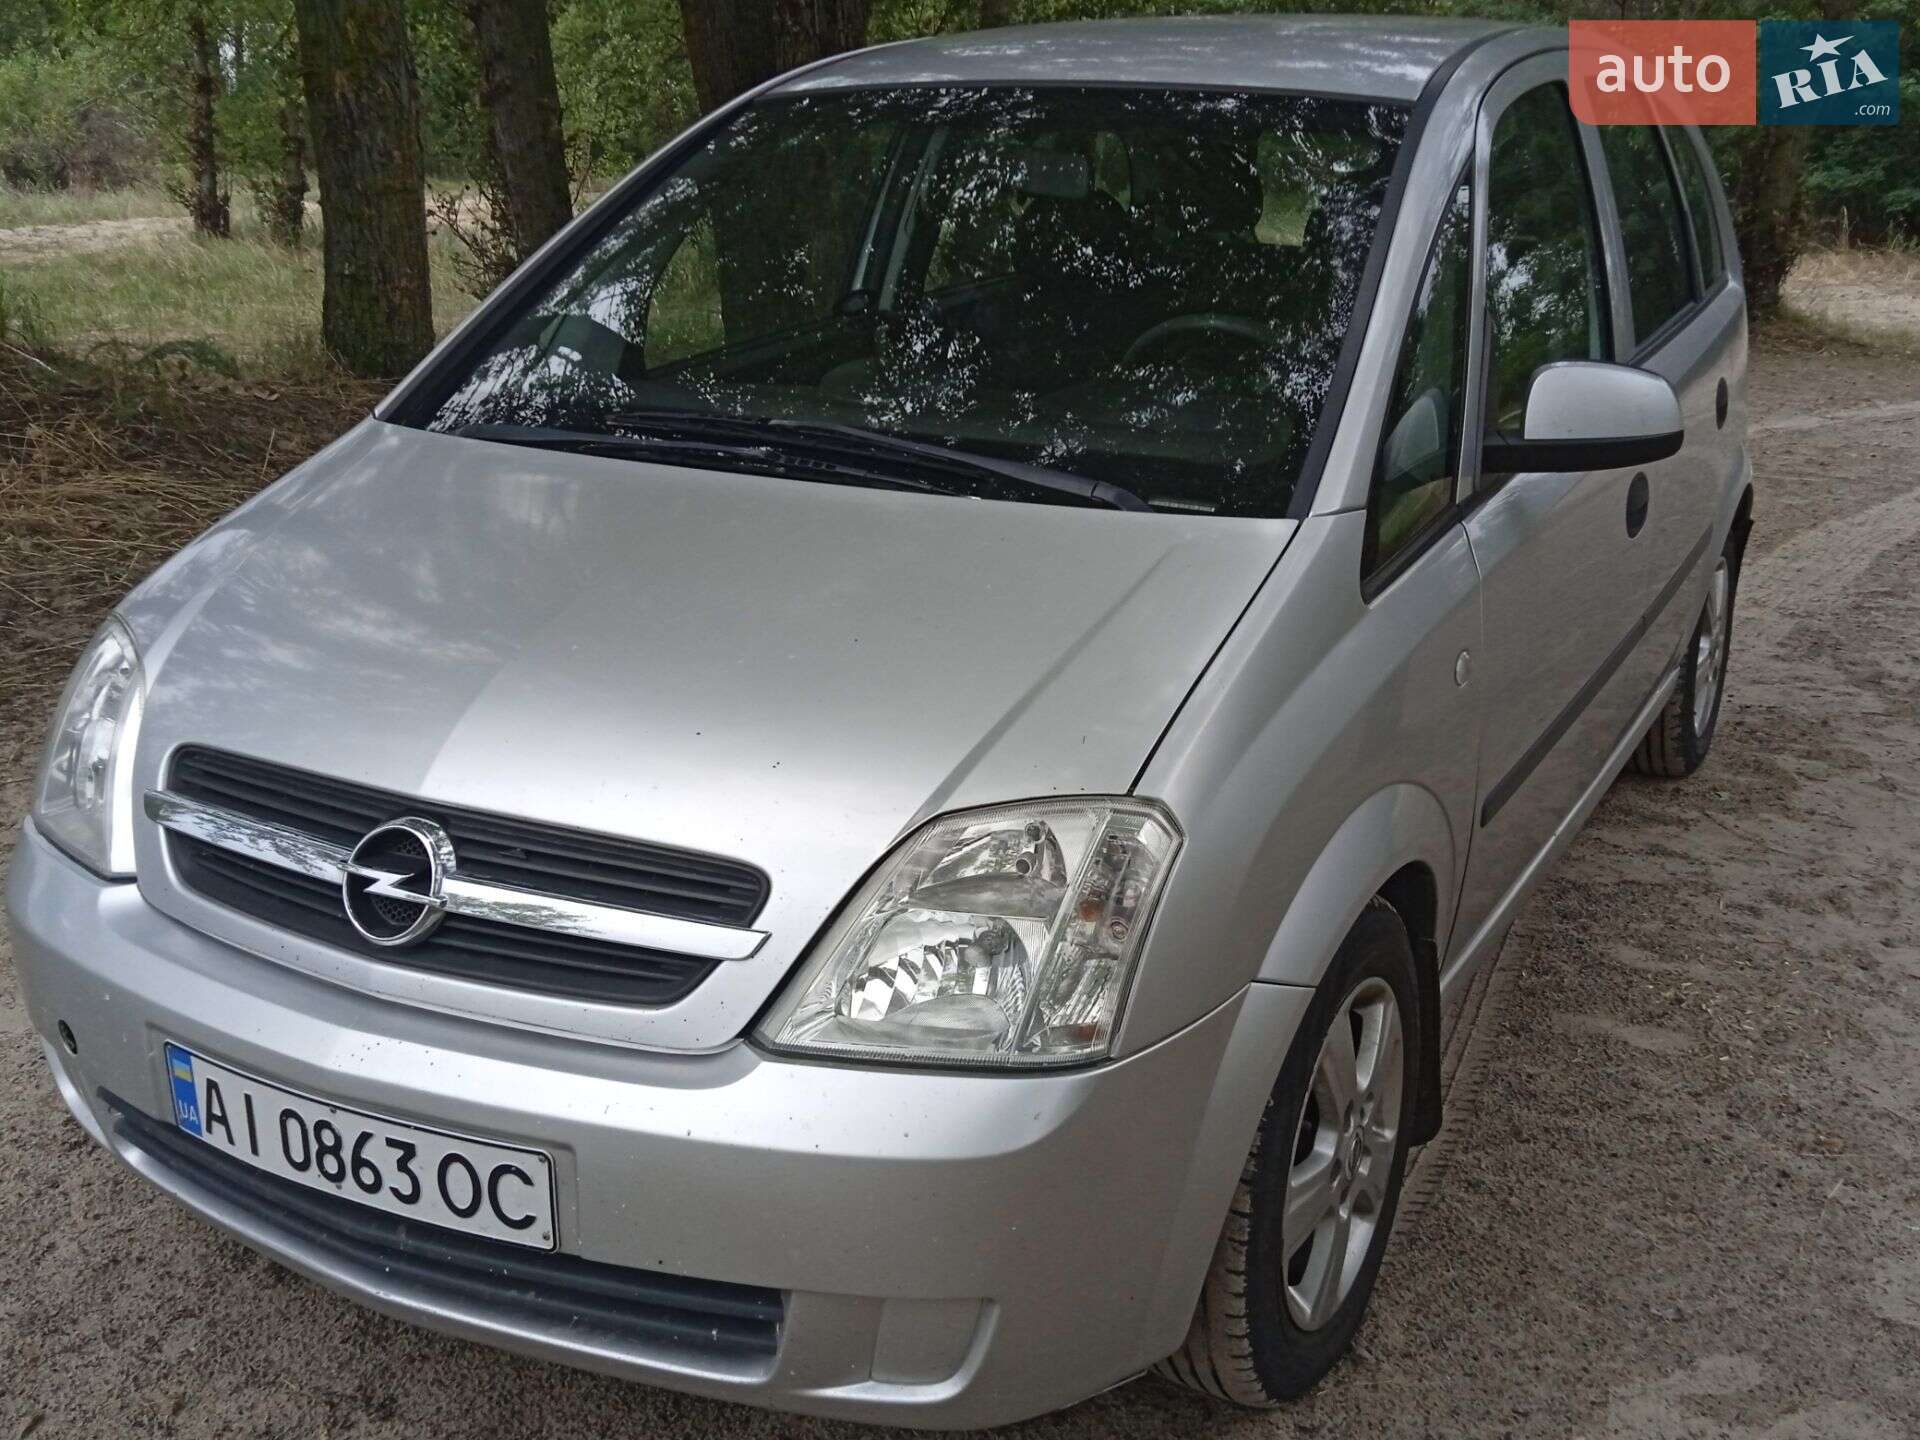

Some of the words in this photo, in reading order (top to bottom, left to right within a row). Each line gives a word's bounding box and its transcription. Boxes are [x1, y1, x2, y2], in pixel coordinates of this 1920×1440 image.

[179, 1103, 199, 1126] UA
[205, 1077, 260, 1157] AI
[279, 1107, 422, 1205] 0863
[437, 1152, 537, 1230] OC
